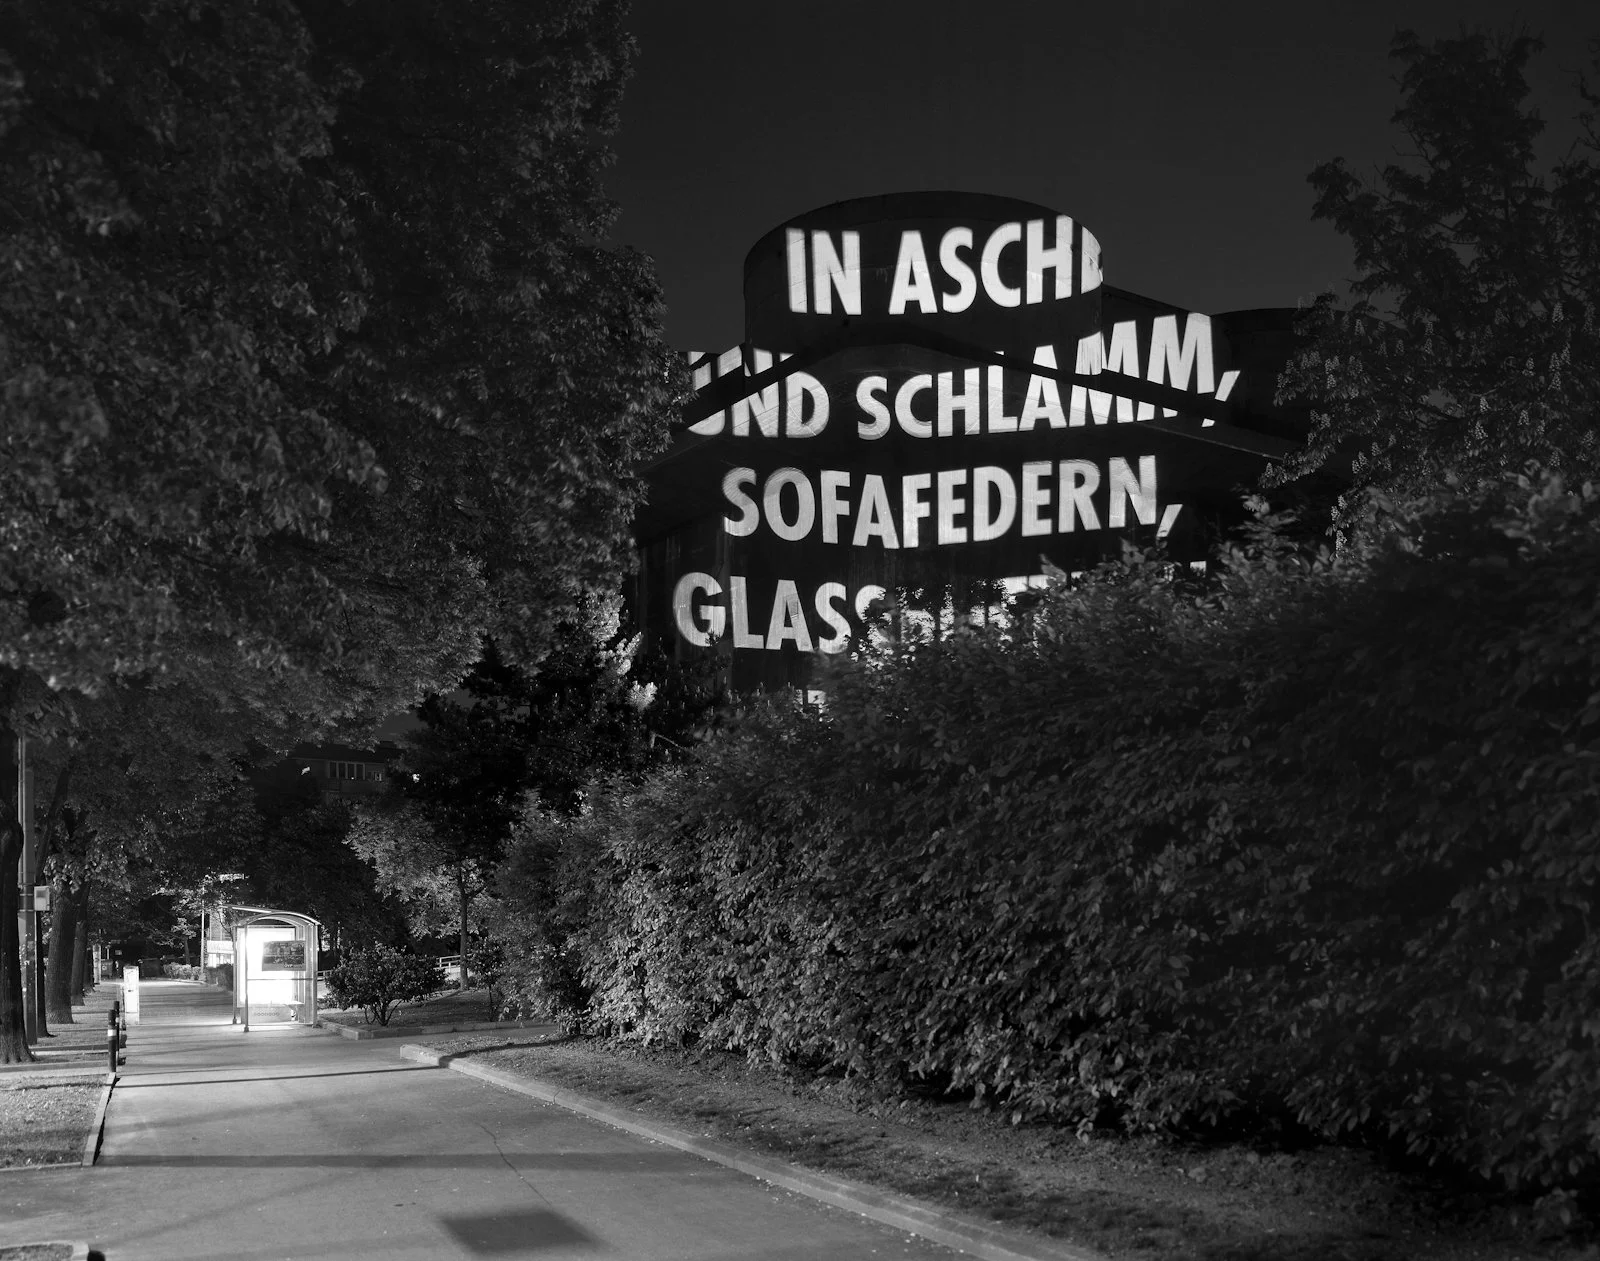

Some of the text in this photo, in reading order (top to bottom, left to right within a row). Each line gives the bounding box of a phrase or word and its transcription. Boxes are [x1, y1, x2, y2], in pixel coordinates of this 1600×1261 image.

[786, 228, 861, 316] IN
[856, 312, 1241, 440] SCHLAMM,
[722, 454, 1183, 550] SOFAFEDERN,
